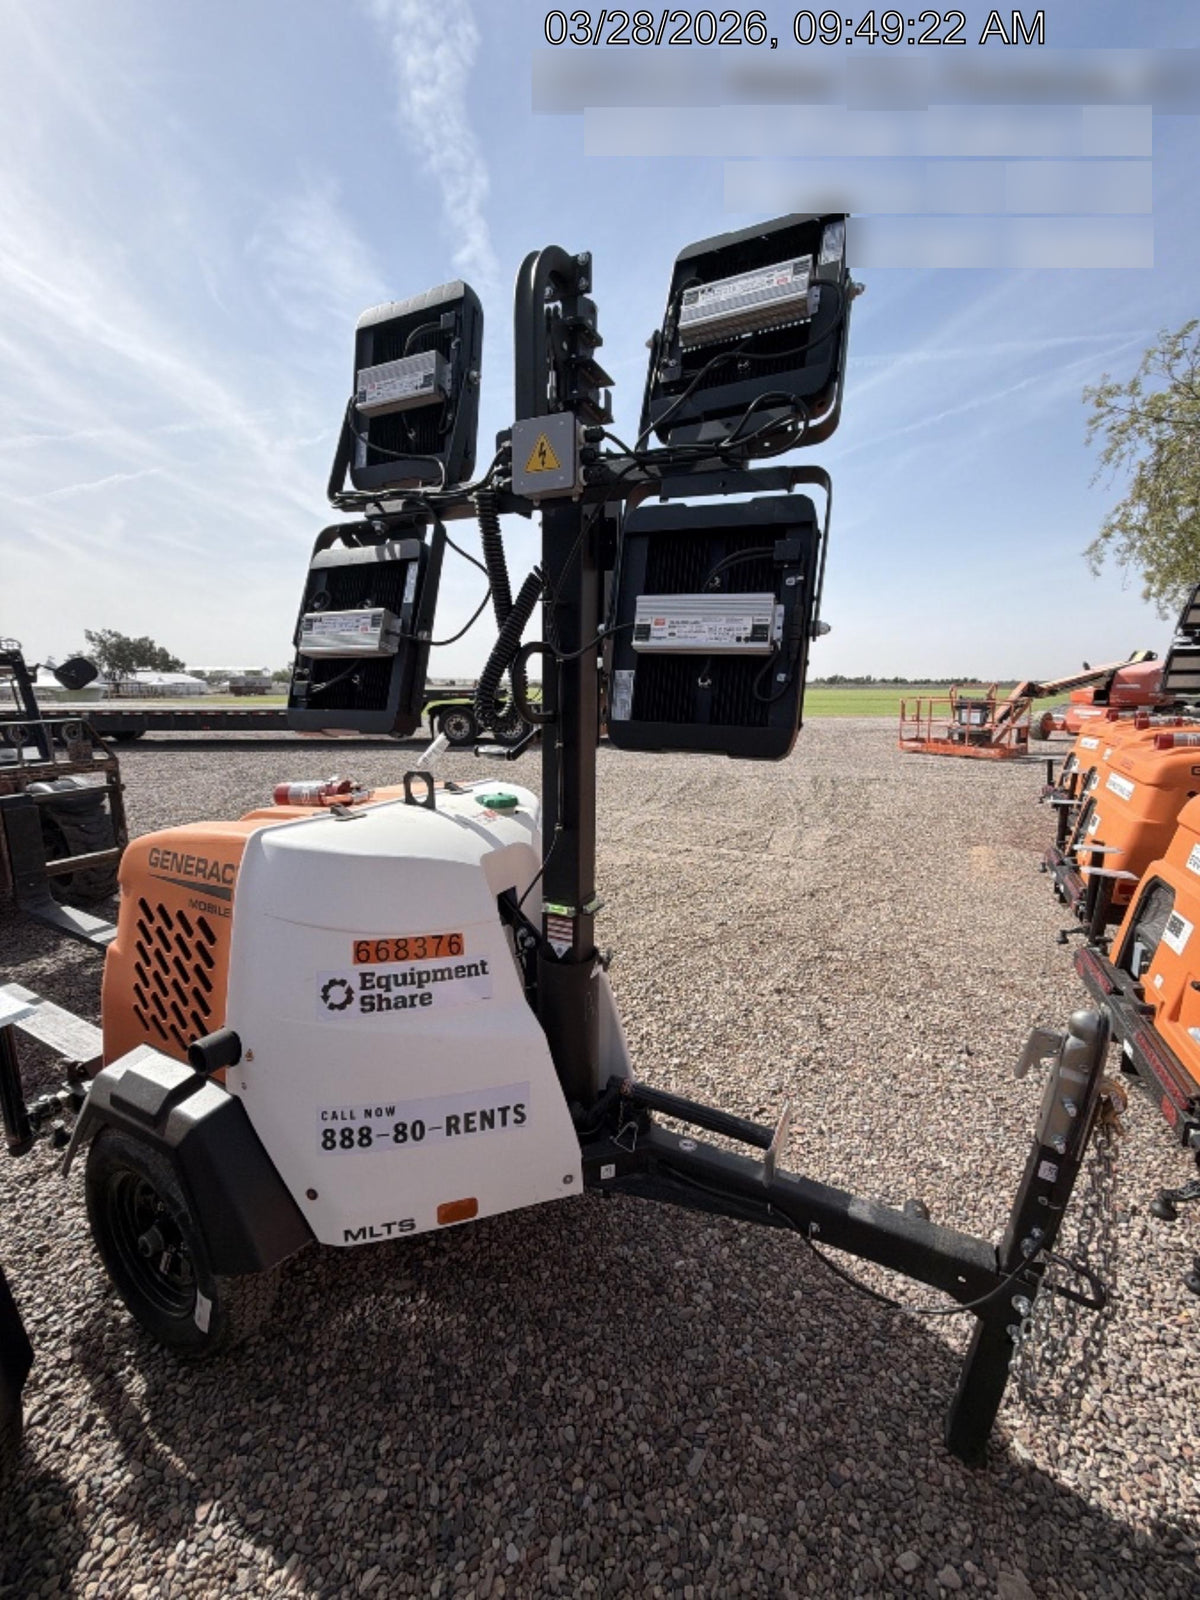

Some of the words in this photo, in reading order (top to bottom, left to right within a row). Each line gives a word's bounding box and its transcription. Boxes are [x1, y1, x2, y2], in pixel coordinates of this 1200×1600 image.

[148, 847, 236, 885] GENERAC
[188, 898, 231, 918] MOBILE
[355, 933, 462, 963] 668376
[359, 959, 489, 992] Equipment
[360, 991, 433, 1014] Share
[321, 1109, 356, 1121] CALL
[364, 1105, 396, 1119] NOW
[321, 1103, 527, 1151] 888-80-RENTS
[343, 1218, 417, 1243] MLTS
